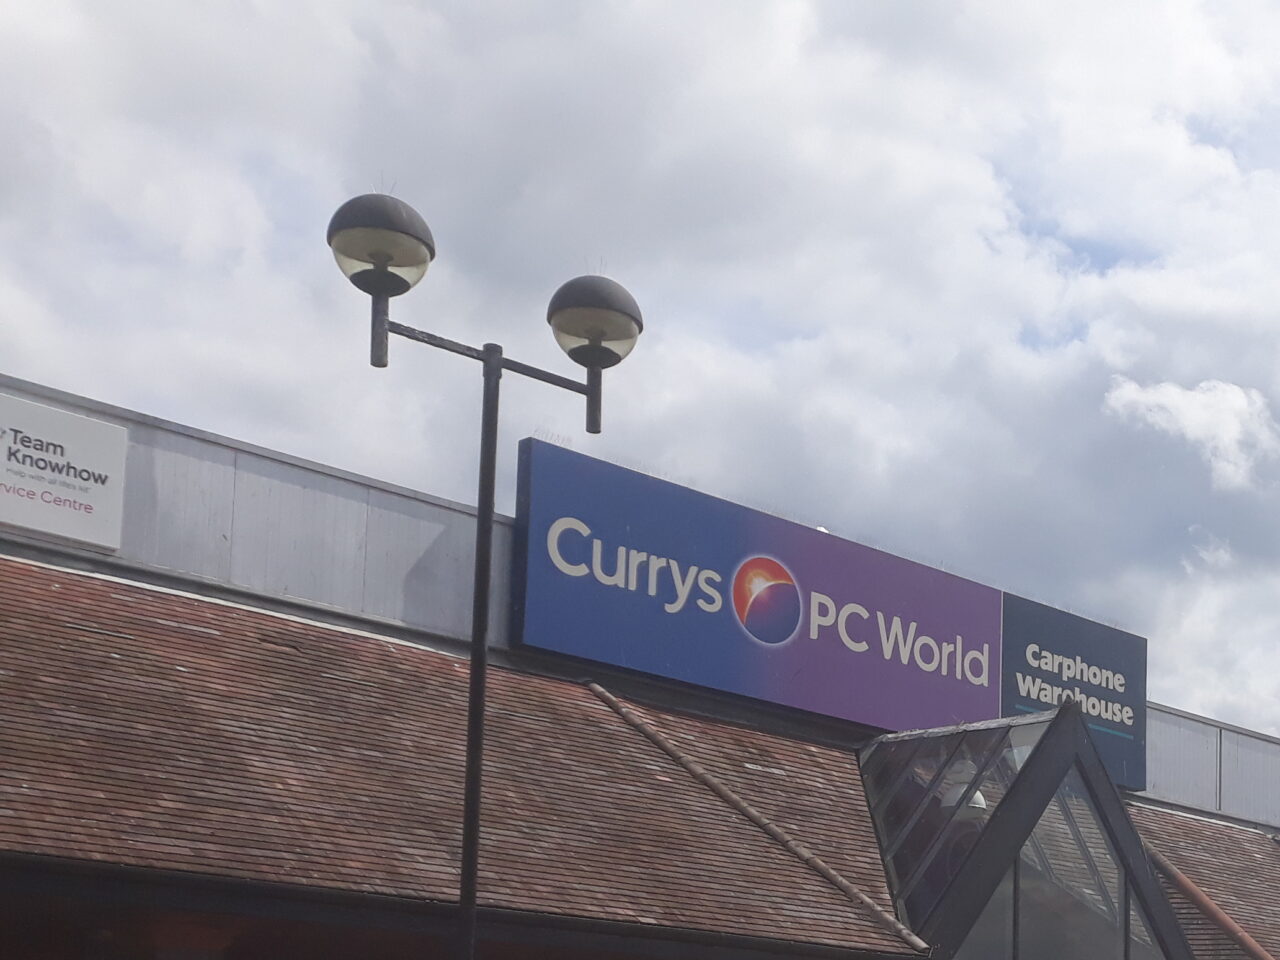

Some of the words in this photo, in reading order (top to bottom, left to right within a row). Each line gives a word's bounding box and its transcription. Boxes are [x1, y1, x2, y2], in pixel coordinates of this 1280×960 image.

[9, 428, 64, 457] Team
[7, 446, 108, 486] Knowhow
[40, 490, 94, 514] Centre
[546, 517, 723, 614] Currys
[809, 591, 869, 652] PC
[877, 611, 990, 687] World
[1025, 643, 1125, 693] Carphone
